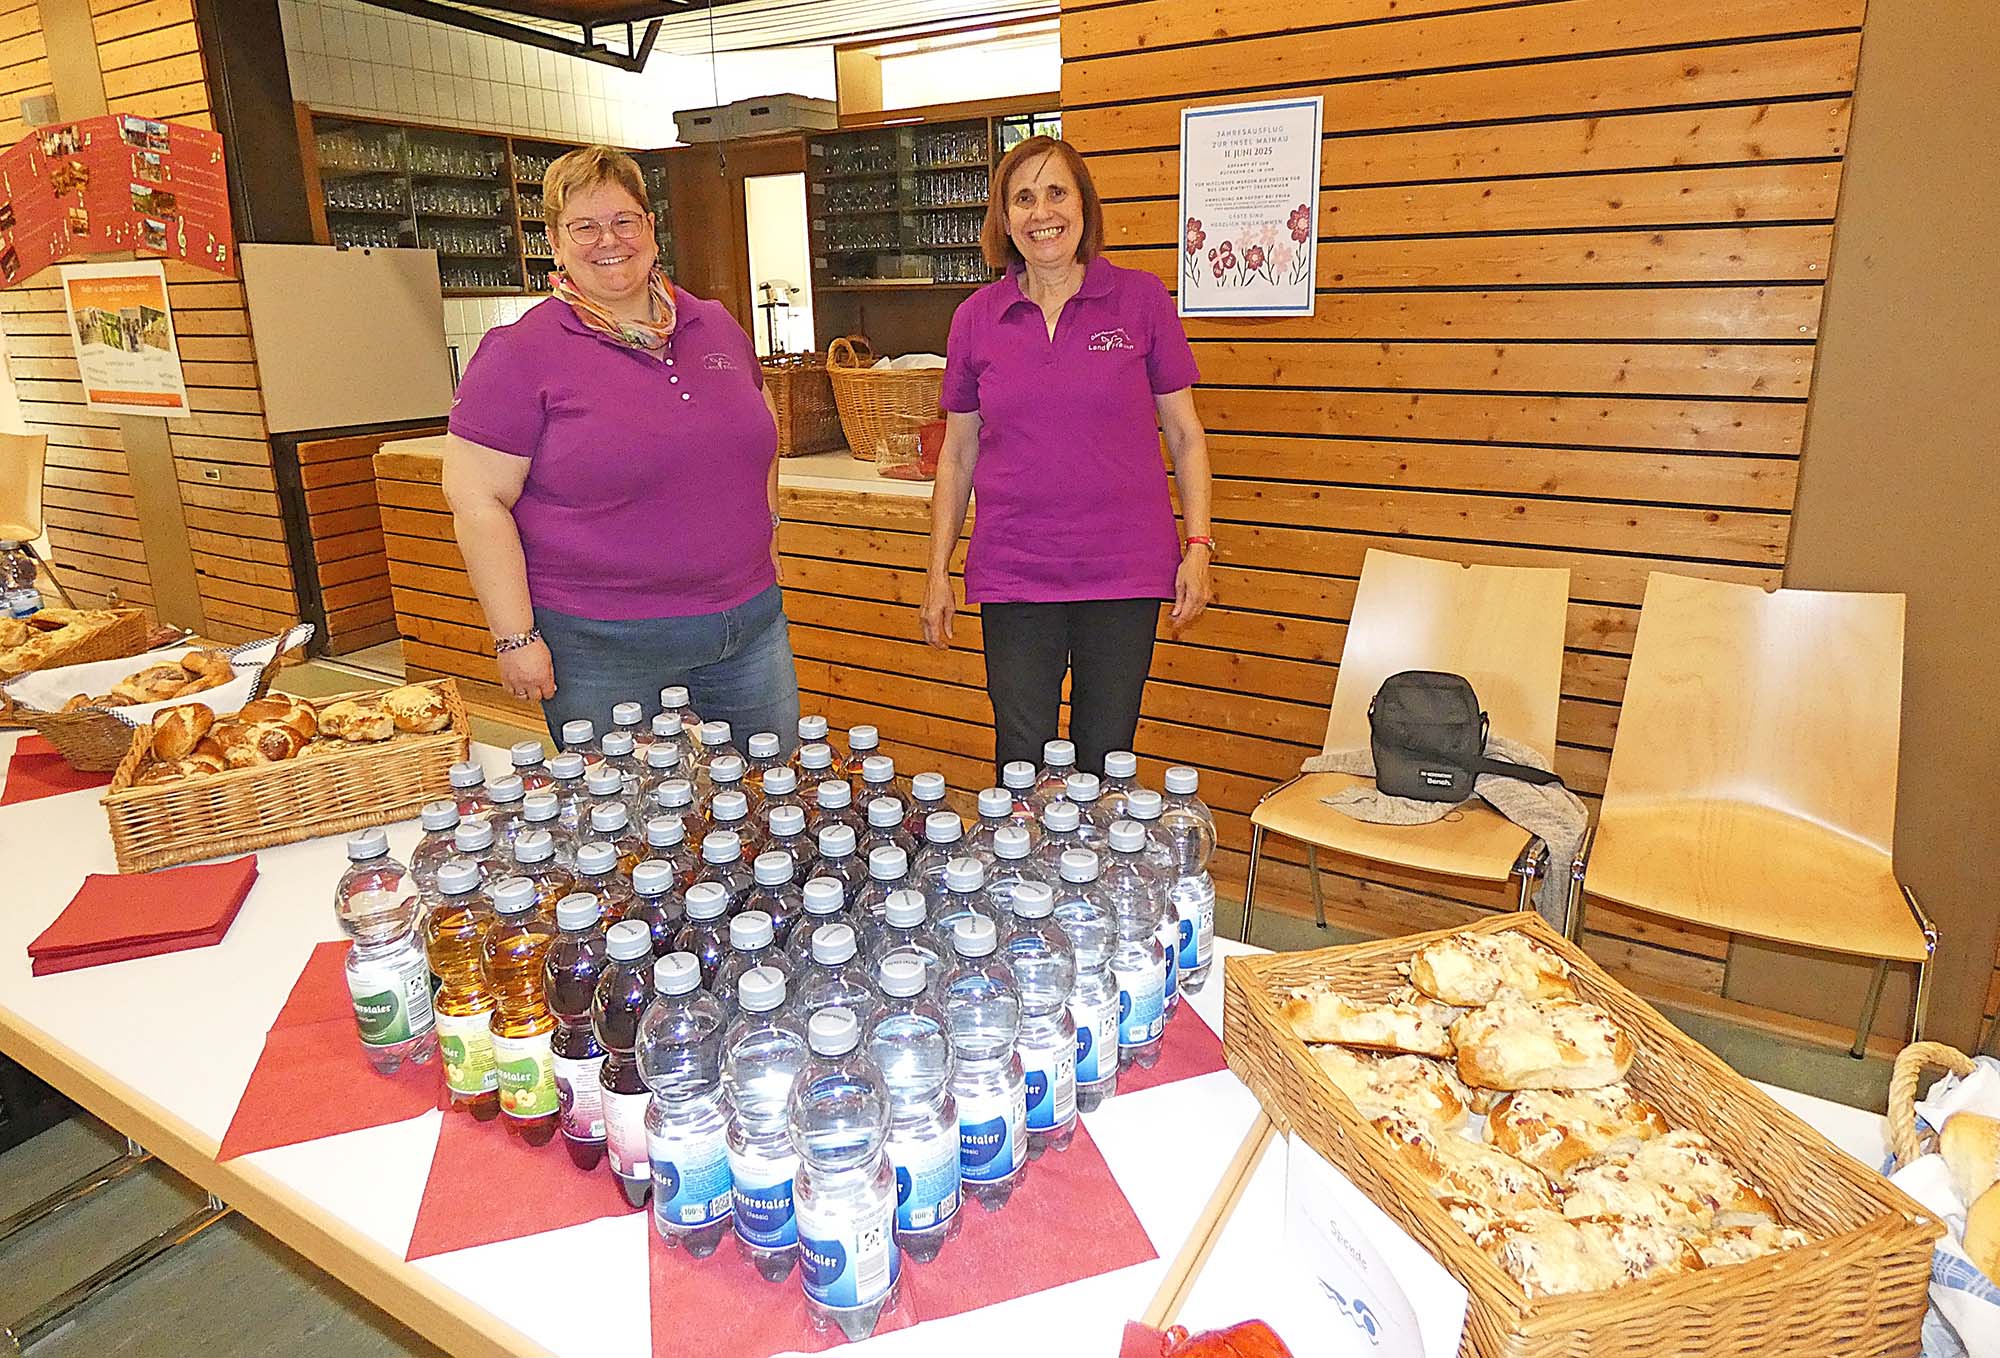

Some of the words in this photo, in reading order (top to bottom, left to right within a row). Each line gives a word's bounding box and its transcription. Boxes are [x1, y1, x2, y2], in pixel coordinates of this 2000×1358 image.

[1216, 126, 1284, 137] JAHRESAUSFLUG
[1212, 141, 1227, 149] ZUR
[1230, 138, 1252, 147] INSEL
[1256, 135, 1289, 144] MAINAU
[1233, 148, 1252, 158] JUNI
[1254, 146, 1273, 156] 2025
